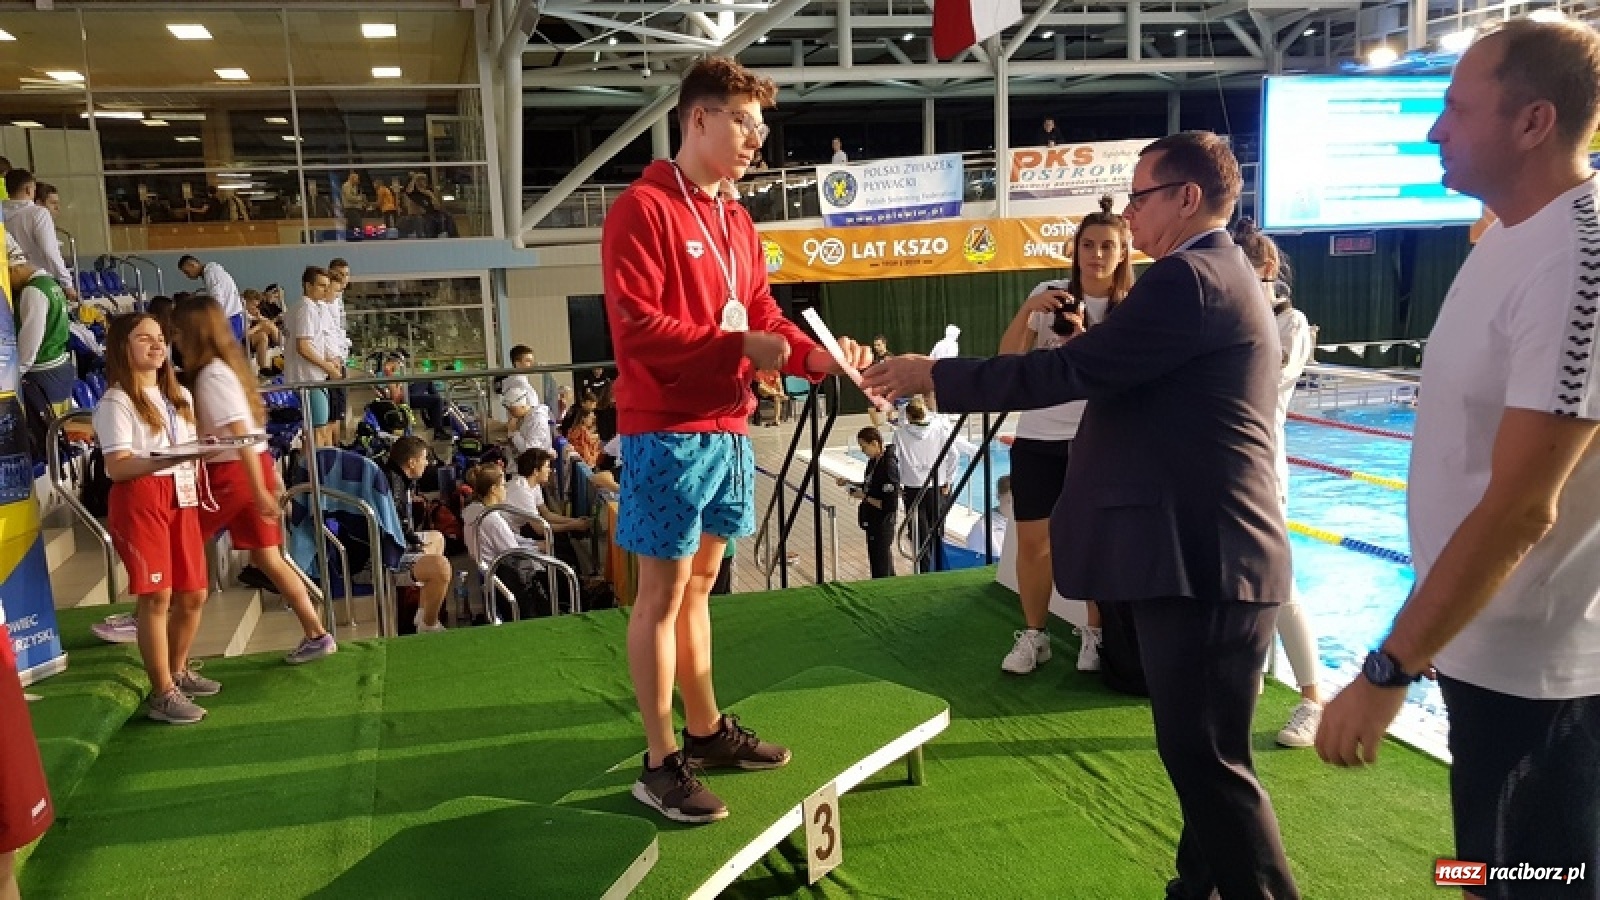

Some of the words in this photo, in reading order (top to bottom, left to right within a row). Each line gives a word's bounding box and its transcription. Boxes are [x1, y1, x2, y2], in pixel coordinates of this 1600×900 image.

[863, 165, 900, 179] POLSKI
[1010, 146, 1094, 182] PKS
[1021, 164, 1132, 180] OSTROW
[1040, 223, 1079, 237] OSTR
[852, 241, 886, 259] LAT
[894, 237, 949, 257] KSZO
[814, 802, 835, 861] 3
